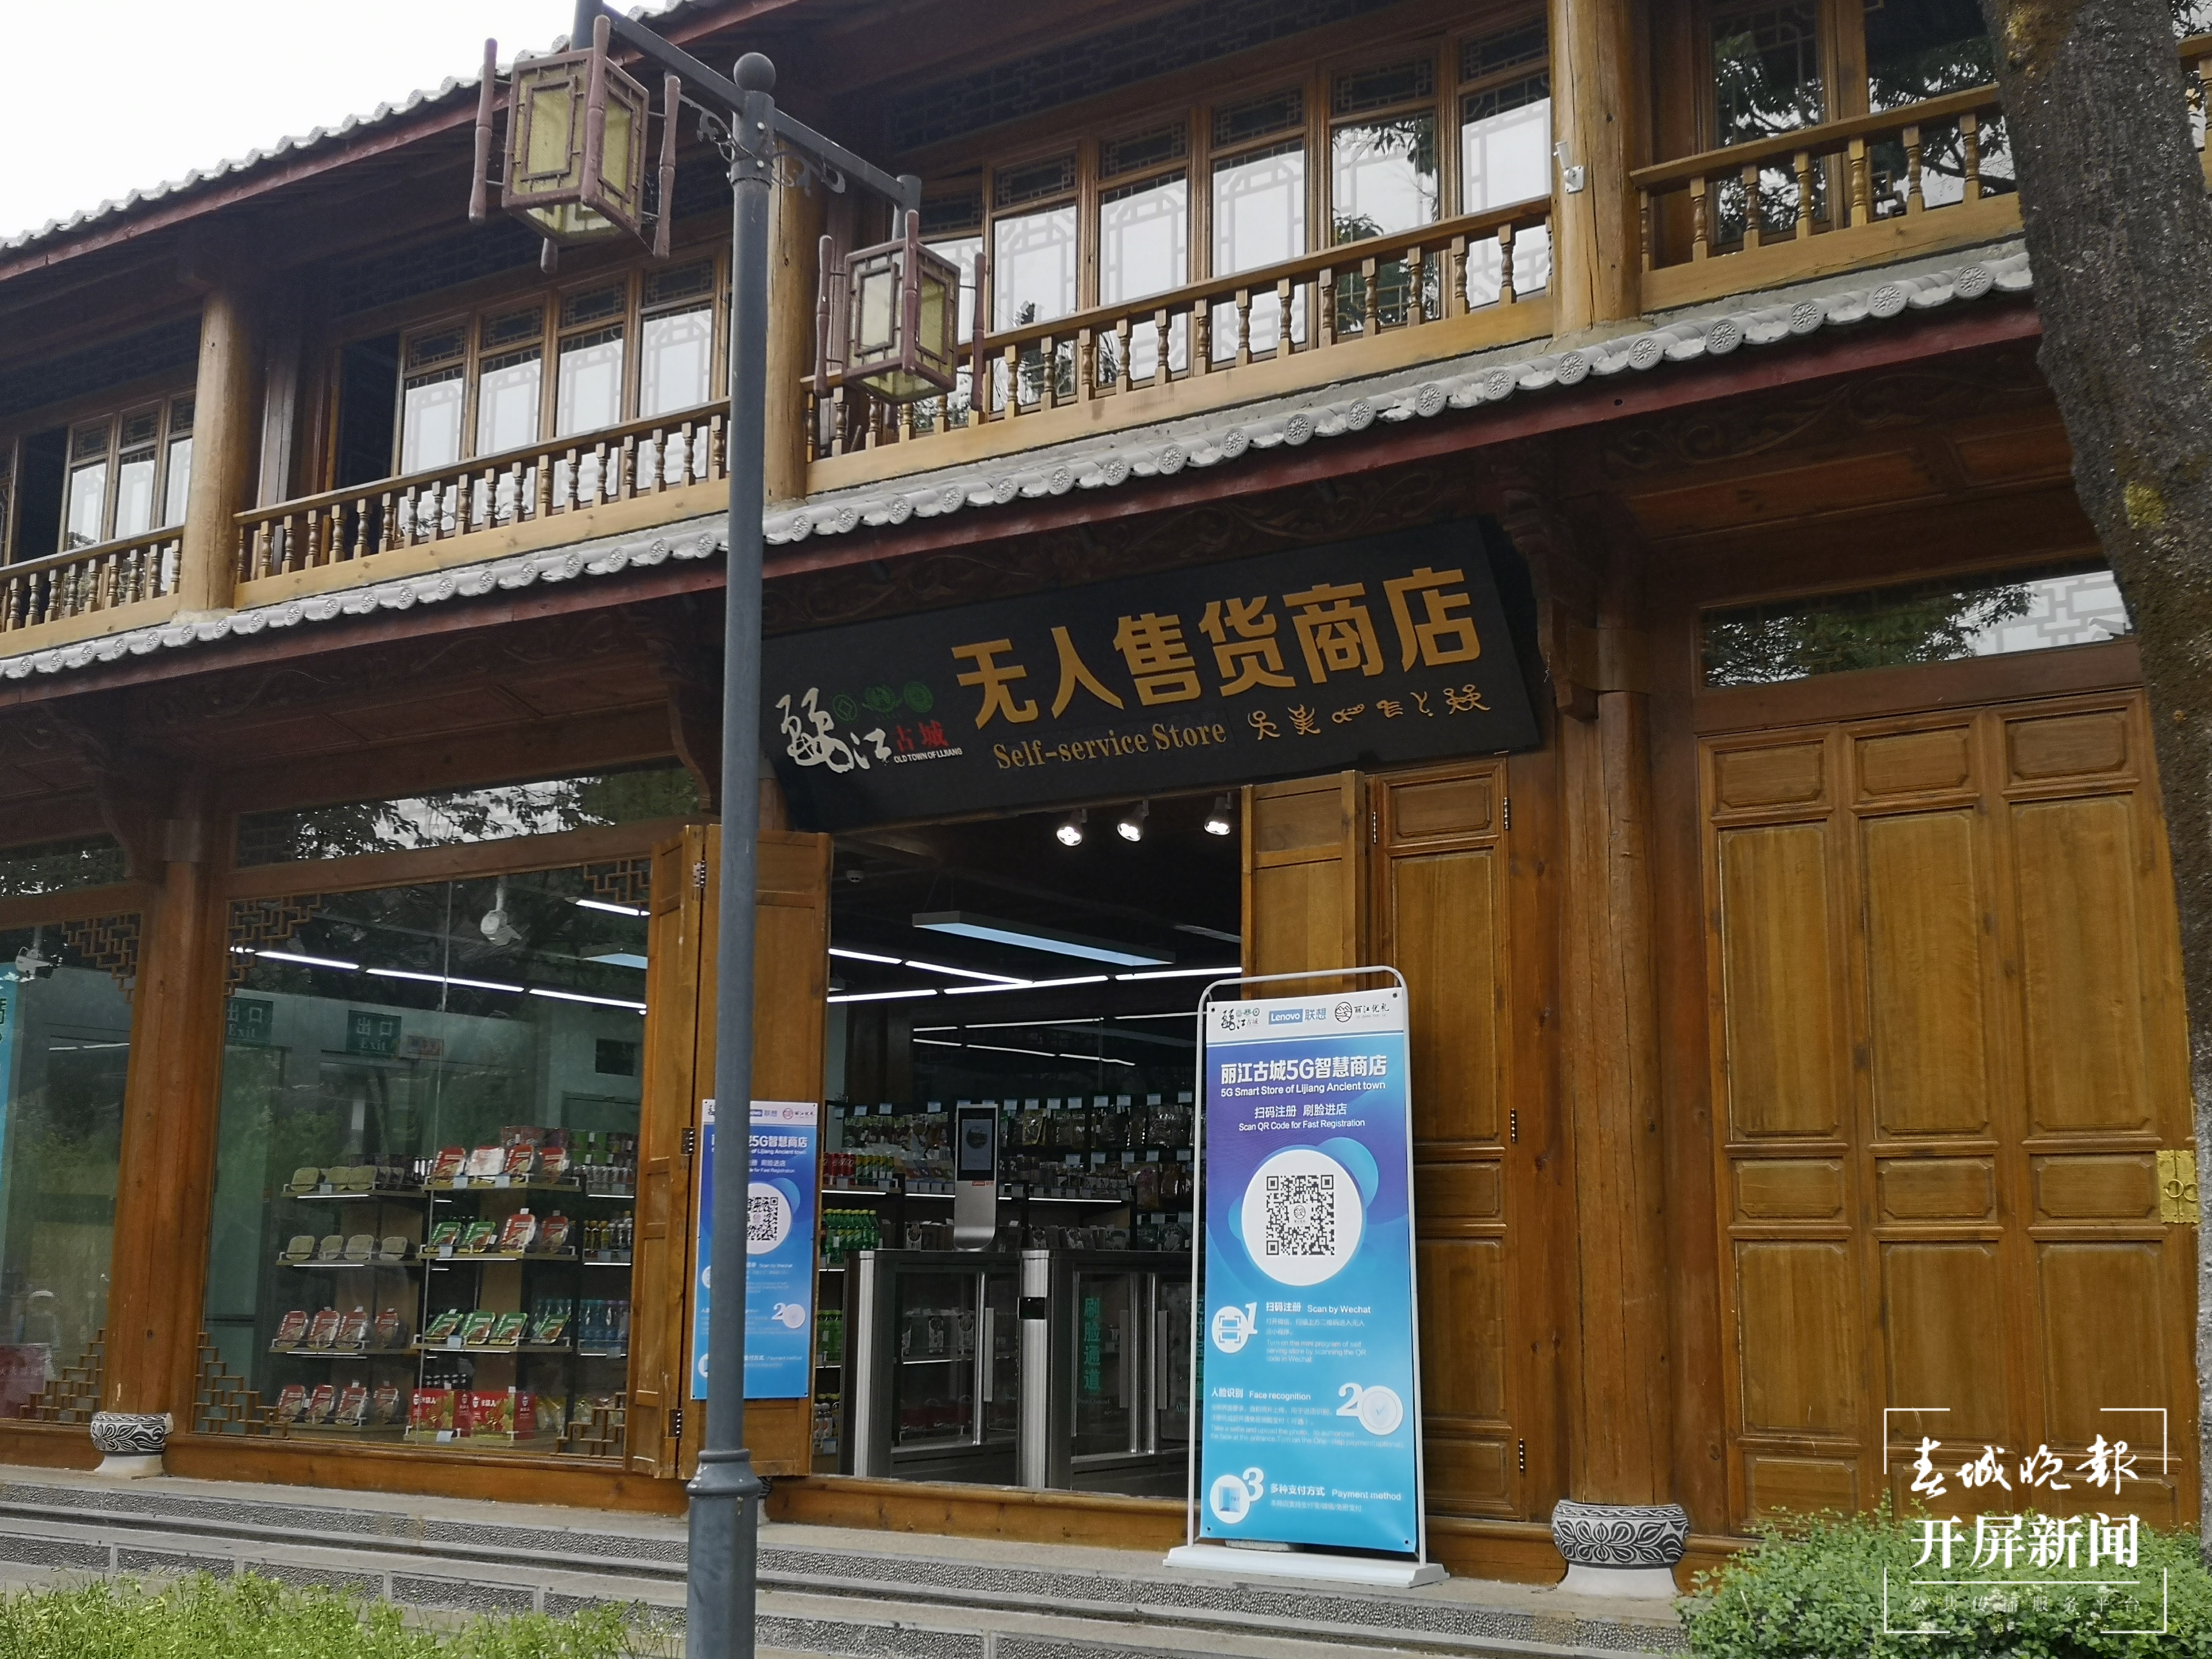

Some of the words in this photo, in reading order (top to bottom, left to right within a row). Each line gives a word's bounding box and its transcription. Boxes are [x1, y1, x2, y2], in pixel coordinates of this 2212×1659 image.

[951, 567, 1481, 729] 无人售货商店
[993, 729, 1149, 769] Self-service
[1152, 723, 1227, 751] Store
[907, 752, 928, 762] TOWN
[927, 751, 937, 759] OF
[1304, 1008, 1326, 1021] 联想
[1354, 1003, 1389, 1013] 丽江优礼
[1270, 1011, 1301, 1022] Lenovo
[1221, 1054, 1387, 1084] 丽江古城5G智慧商店
[1221, 1088, 1233, 1097] 5G
[1235, 1087, 1259, 1096] Smart
[1261, 1085, 1283, 1095] Store
[1285, 1084, 1295, 1093] of
[1296, 1084, 1325, 1094] Lijiang
[1327, 1082, 1361, 1091] Ancient
[1363, 1081, 1386, 1090] town
[1254, 1105, 1297, 1119] 扫码注册
[1303, 1103, 1347, 1116] 刷脸进店
[1258, 1122, 1270, 1131] QR
[1321, 1119, 1365, 1129] Registration
[771, 1303, 786, 1320] 2
[1265, 1302, 1301, 1312] 扫码注册
[1329, 1305, 1338, 1314] by
[1245, 1302, 1258, 1334] 1
[1211, 1387, 1244, 1398] 人脸识别
[1249, 1390, 1268, 1399] Face
[1269, 1392, 1311, 1401] recognition
[1336, 1382, 1363, 1416] 2
[1243, 1467, 1264, 1502] 3
[1270, 1483, 1326, 1496] 多种支付方式
[1332, 1489, 1369, 1501] Payment
[1370, 1490, 1401, 1501] method
